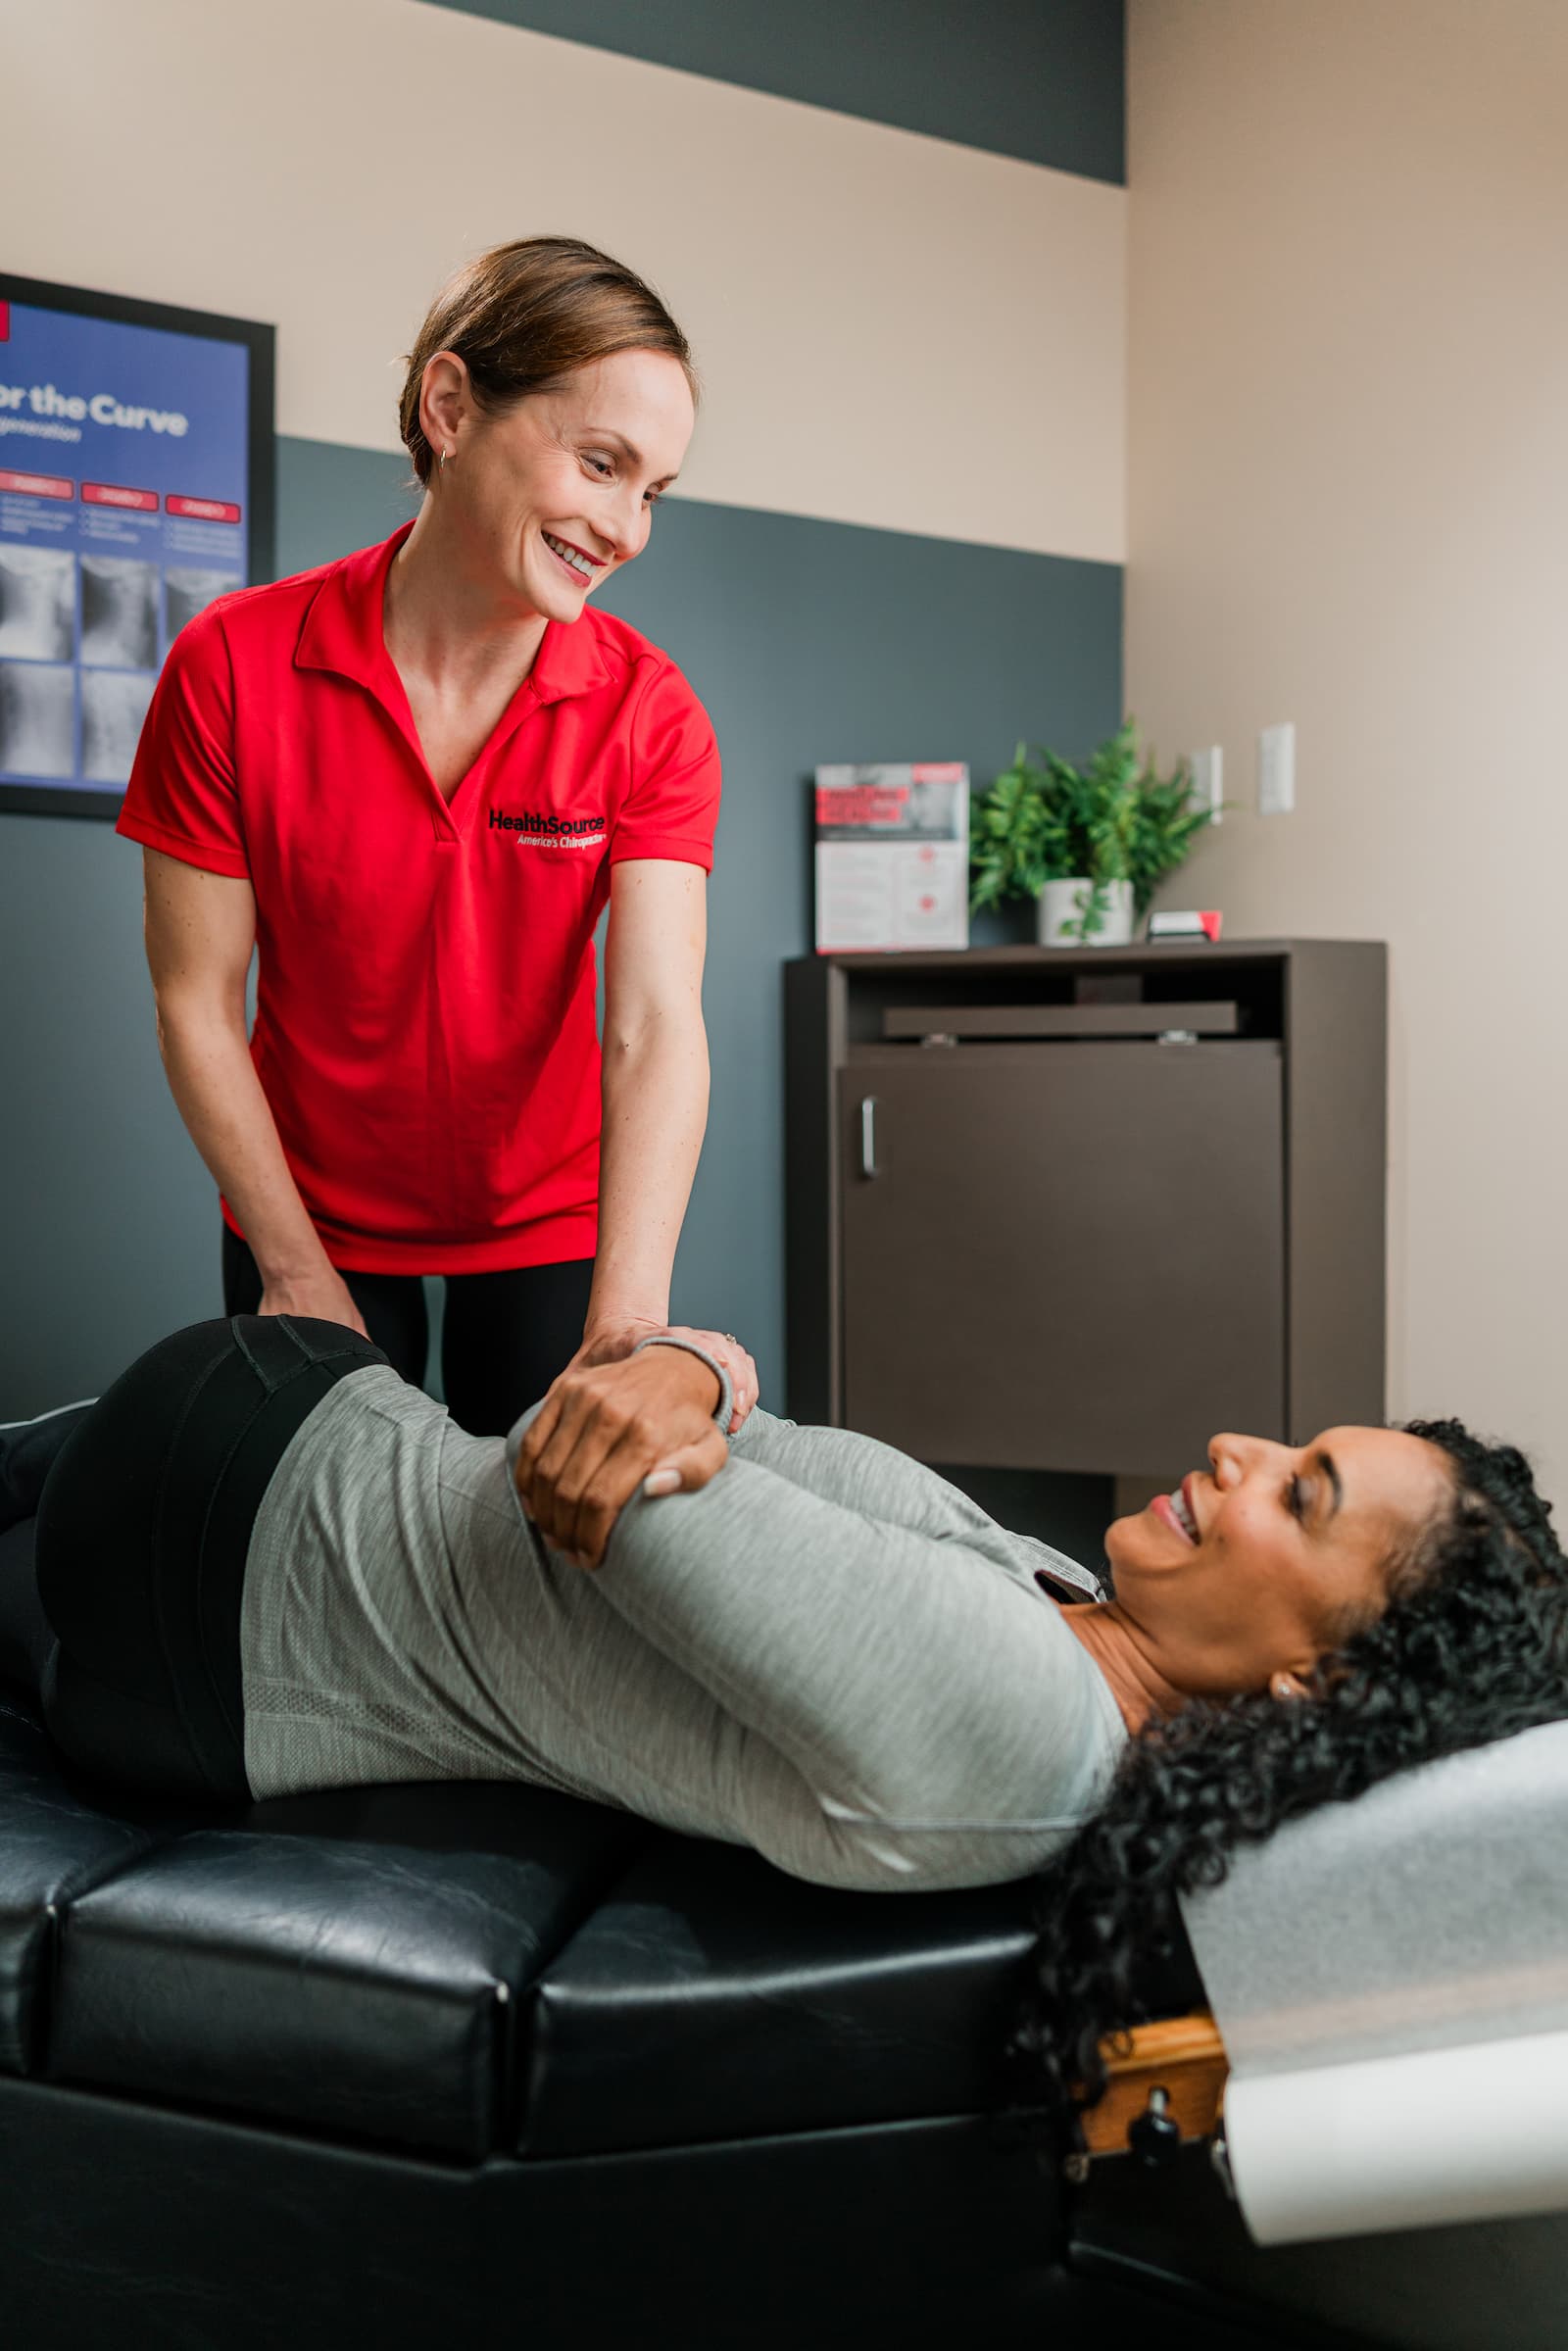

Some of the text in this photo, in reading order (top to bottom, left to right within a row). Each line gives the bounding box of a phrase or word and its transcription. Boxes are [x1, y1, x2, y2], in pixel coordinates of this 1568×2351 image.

[29, 383, 86, 420] the
[89, 394, 188, 437] Curve
[489, 808, 605, 835] HealthSource
[517, 834, 559, 848] America's
